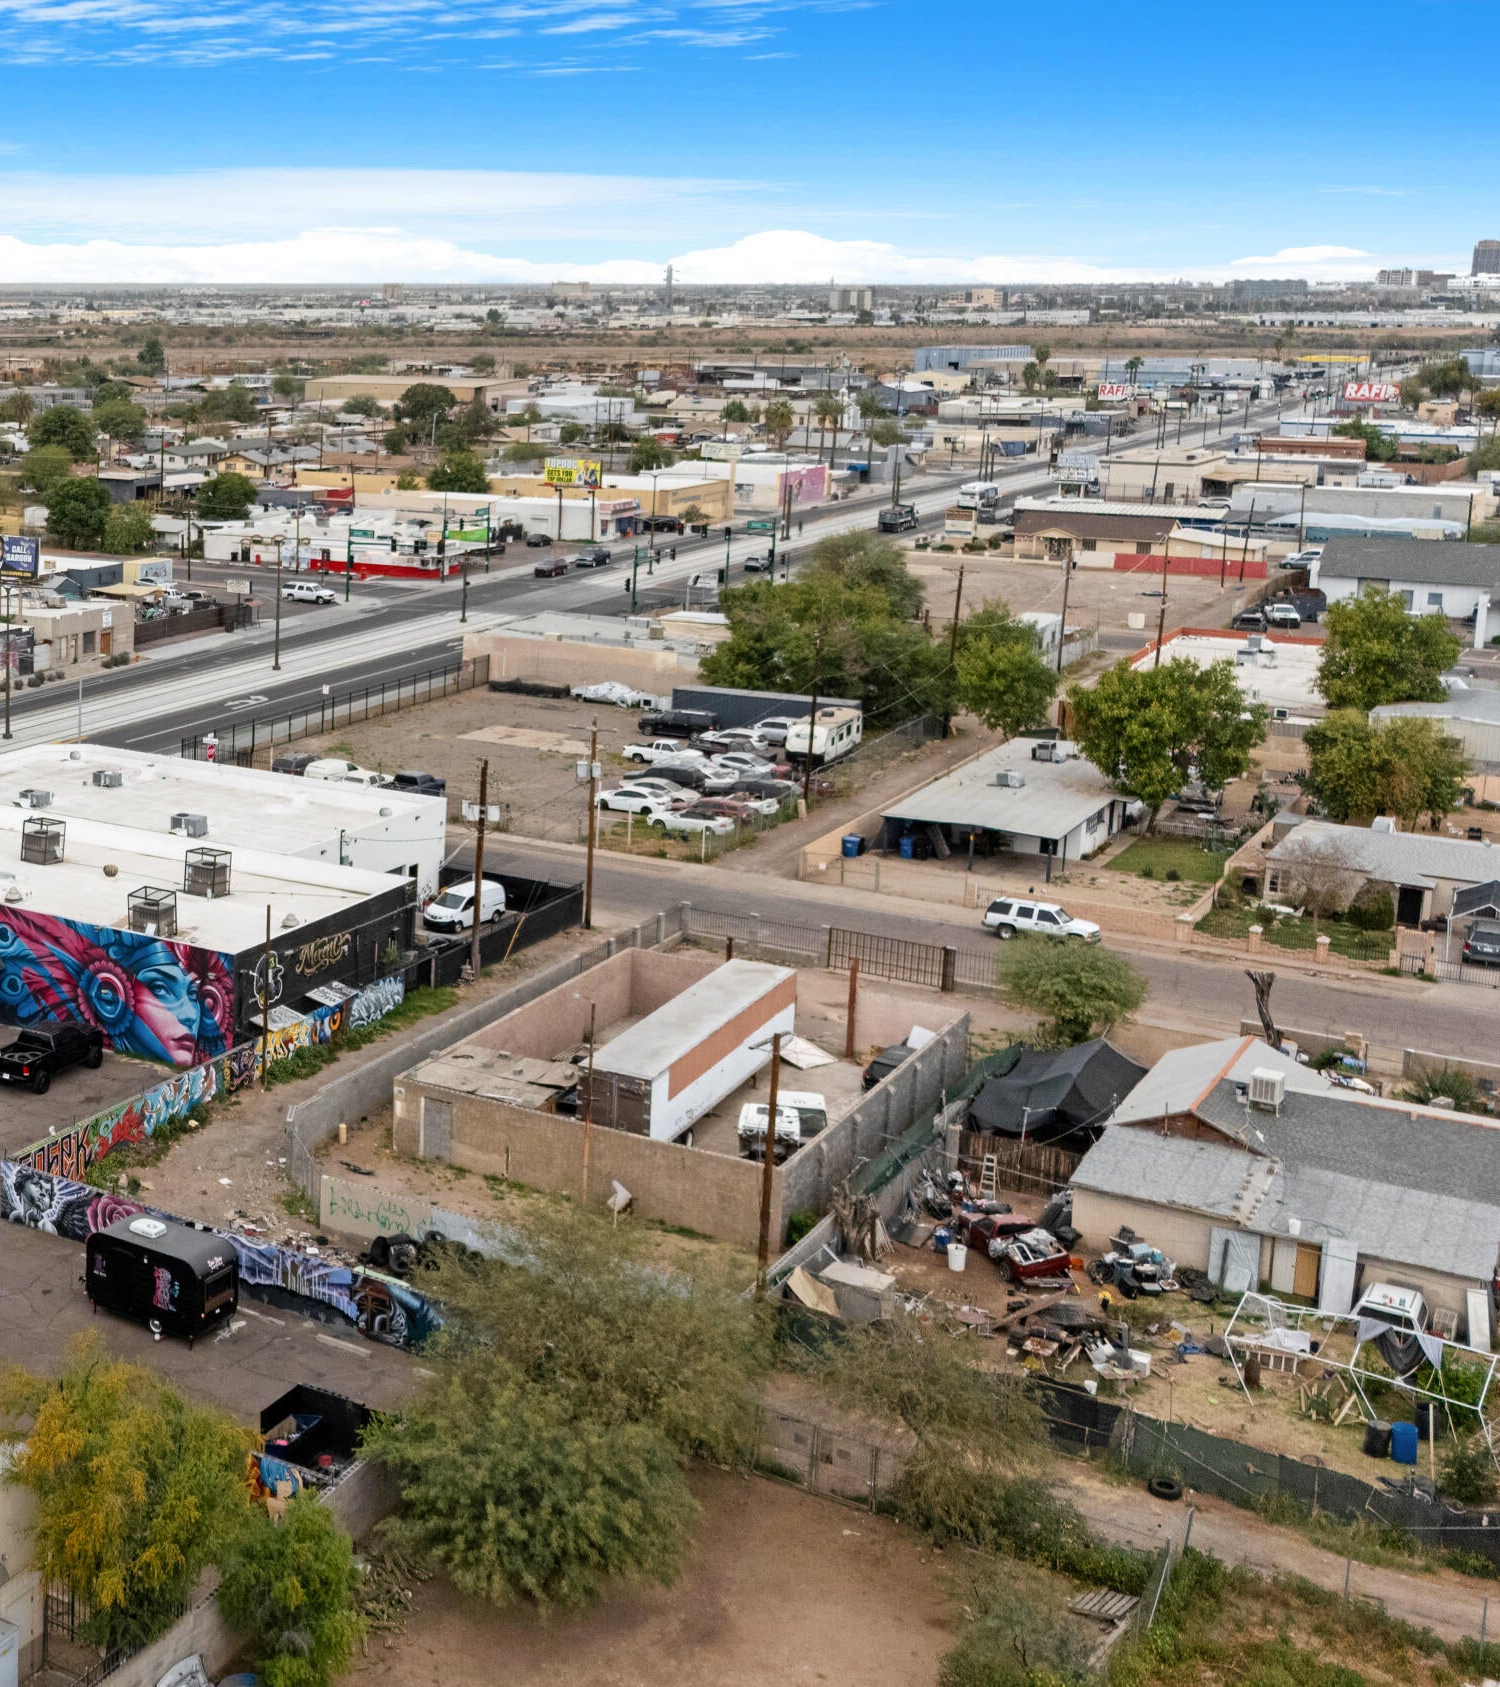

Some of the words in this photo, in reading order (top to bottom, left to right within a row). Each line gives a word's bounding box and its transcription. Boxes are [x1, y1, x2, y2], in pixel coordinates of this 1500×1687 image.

[1099, 384, 1125, 396] RAFI
[1345, 383, 1387, 401] RAFI
[11, 545, 27, 554] CALL
